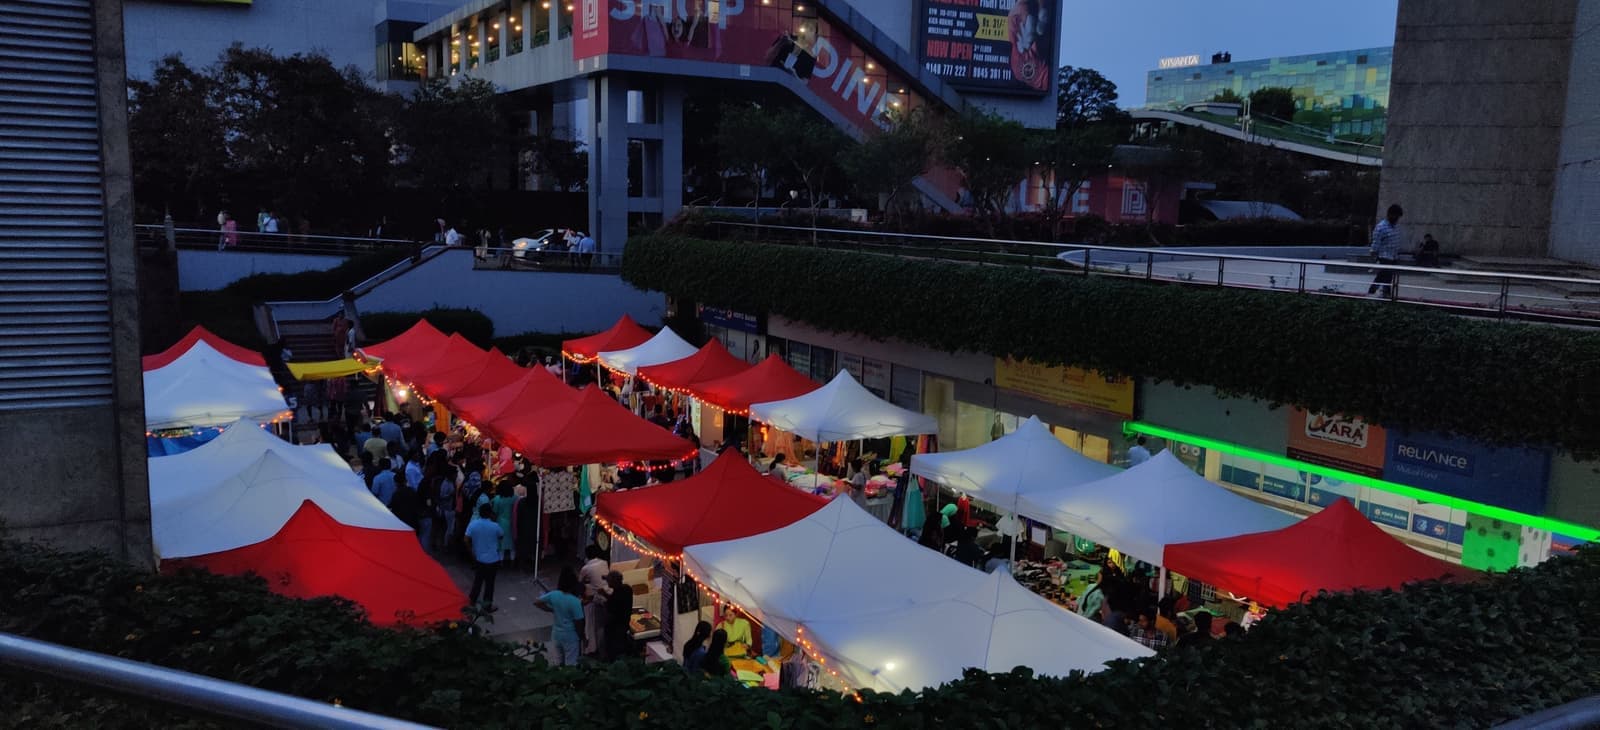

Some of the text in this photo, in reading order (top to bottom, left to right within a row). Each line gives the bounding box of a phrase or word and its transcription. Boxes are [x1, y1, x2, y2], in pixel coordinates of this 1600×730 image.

[927, 40, 973, 59] NOW OPEN
[1159, 55, 1200, 69] VIVANTA
[943, 64, 954, 76] 777
